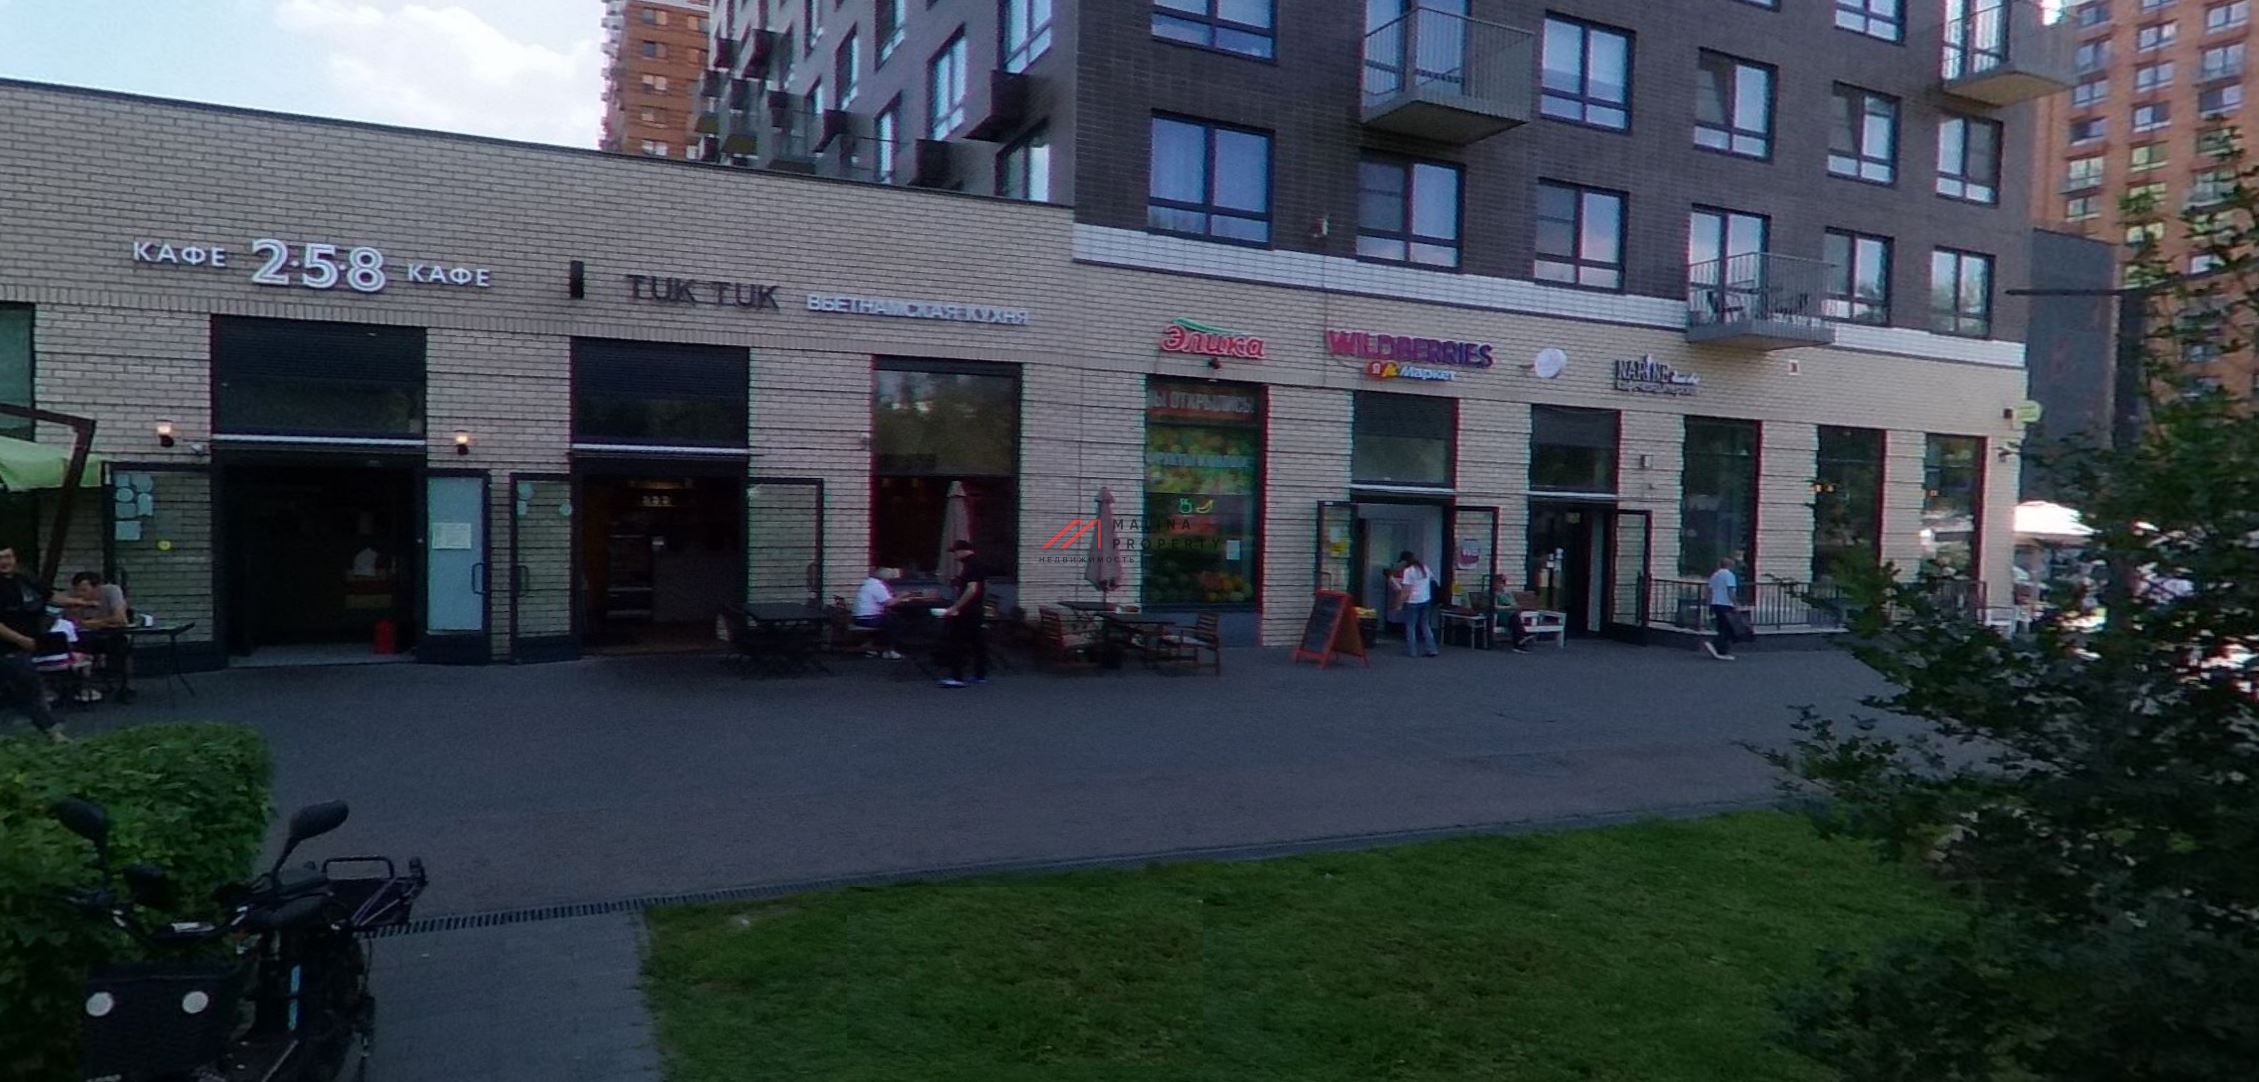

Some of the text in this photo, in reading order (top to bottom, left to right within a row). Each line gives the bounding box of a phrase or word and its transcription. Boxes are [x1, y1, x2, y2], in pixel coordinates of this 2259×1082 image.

[133, 242, 226, 267] КАФЕ
[407, 263, 490, 287] КАФЕ
[626, 274, 779, 311] TUK TUK
[1160, 324, 1265, 359] Элика
[1326, 329, 1494, 369] WILDBERRIES
[1400, 365, 1457, 382] Маркет
